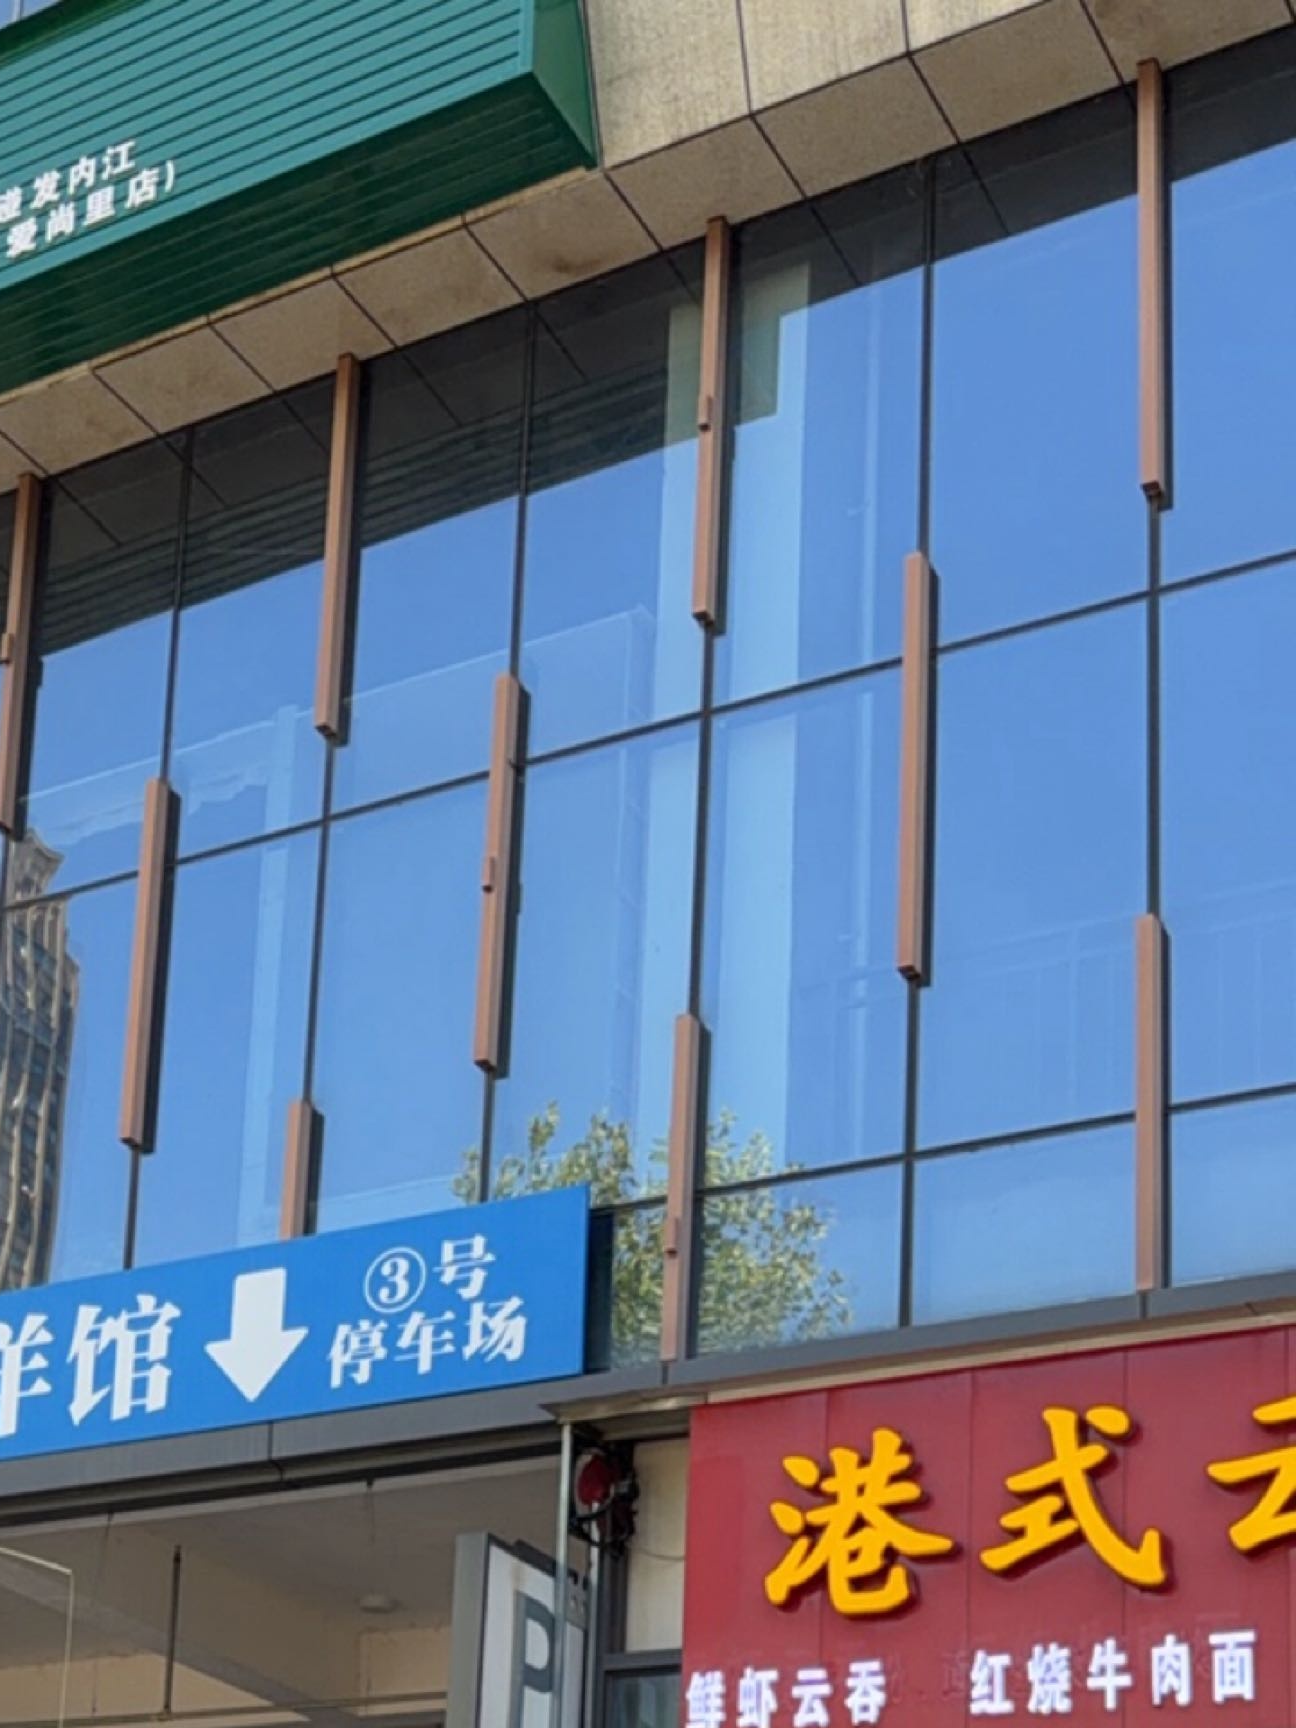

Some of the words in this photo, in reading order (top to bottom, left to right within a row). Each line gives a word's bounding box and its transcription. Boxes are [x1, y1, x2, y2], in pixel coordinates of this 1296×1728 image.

[328, 1296, 527, 1389] 停车场
[969, 1629, 1258, 1716] 红烧牛肉面
